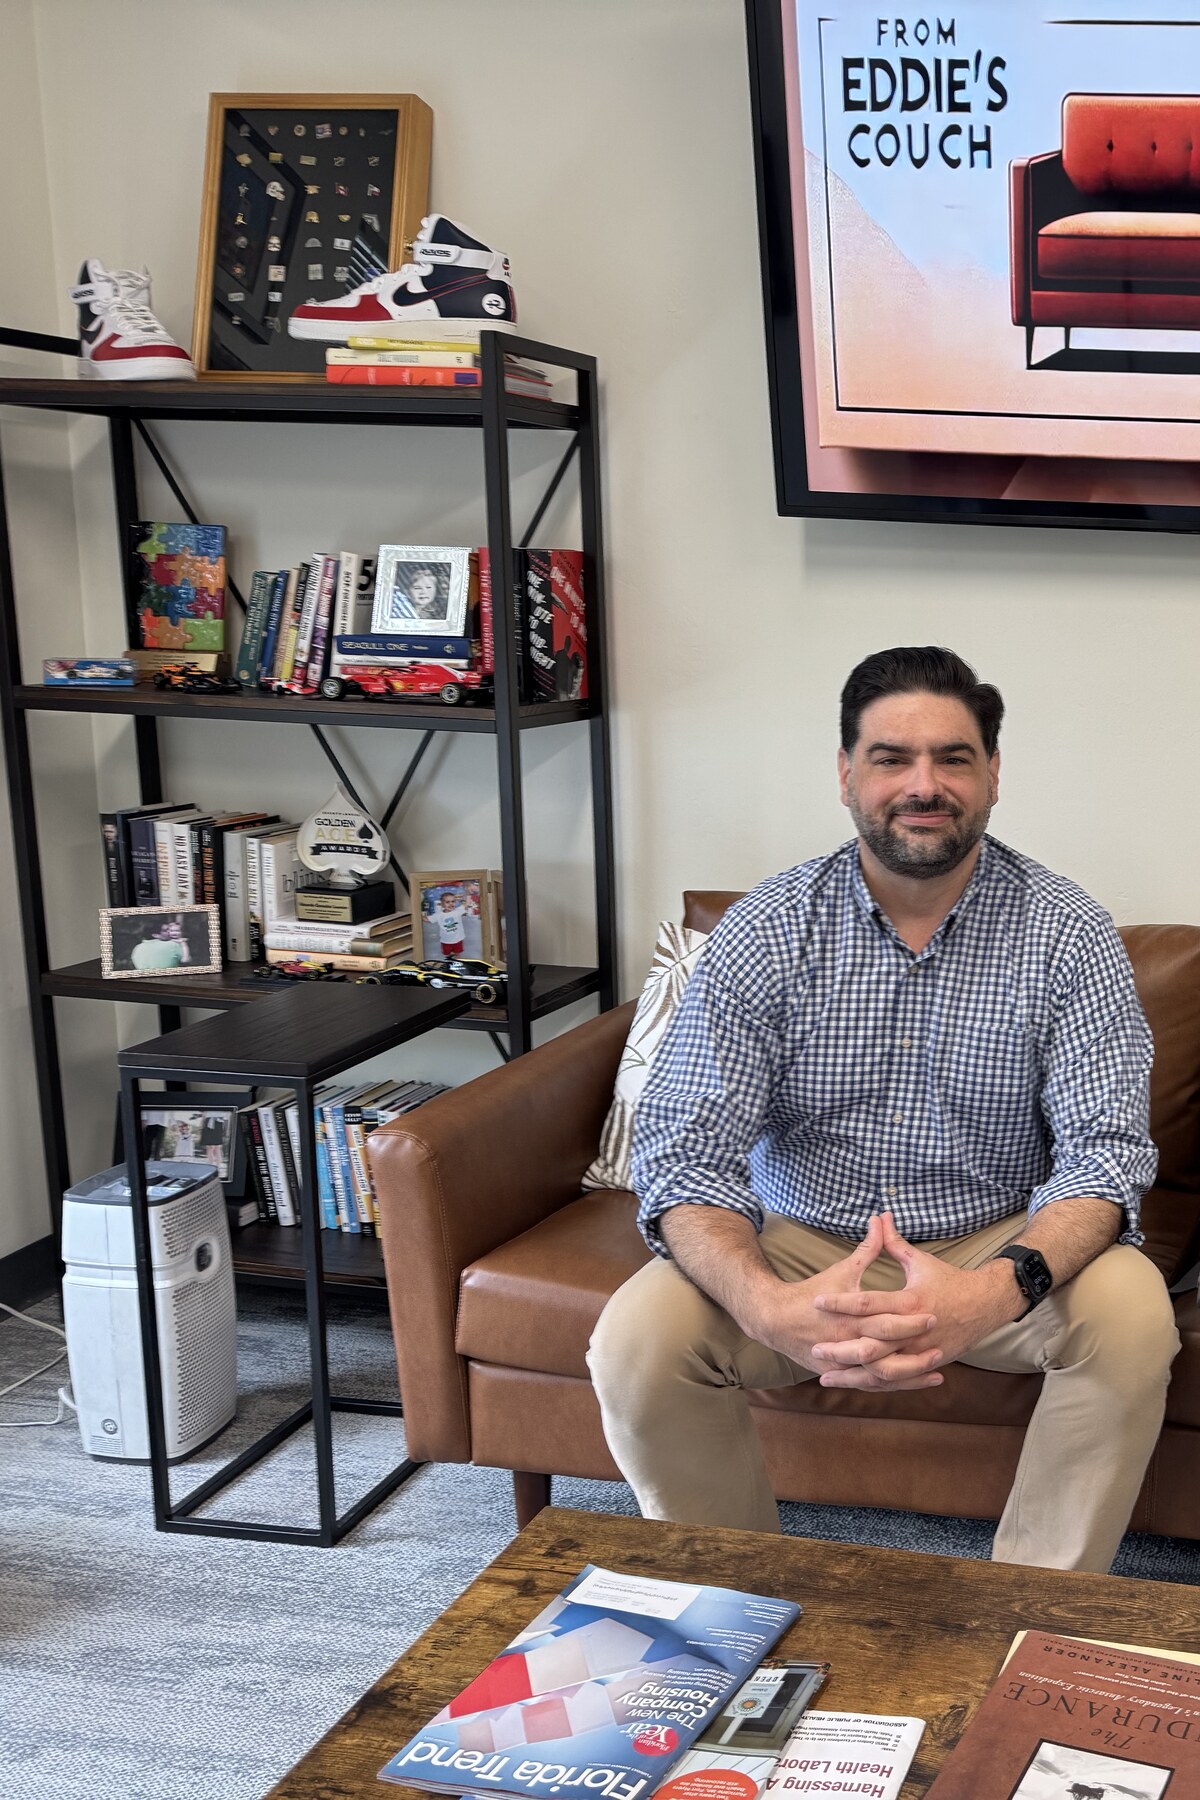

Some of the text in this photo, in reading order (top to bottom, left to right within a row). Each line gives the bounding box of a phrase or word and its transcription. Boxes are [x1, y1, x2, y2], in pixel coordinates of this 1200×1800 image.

[877, 17, 956, 47] FROM
[841, 49, 1008, 113] EDDIE'S
[847, 123, 992, 169] COUCH
[308, 557, 322, 591] ARIZONA
[358, 559, 374, 592] 5
[386, 642, 409, 652] ONE
[314, 818, 356, 828] GOLDEN
[156, 842, 170, 891] INSPIRED
[174, 835, 190, 889] NO EASY DAY
[255, 1146, 277, 1217] HOW THE MIGHTY FALL
[351, 1150, 369, 1192] TECHNOLOGY
[1042, 1645, 1151, 1674] ALEXANDER
[1018, 1671, 1075, 1691] Expedition
[1077, 1684, 1125, 1701] Antarctic
[615, 1691, 708, 1718] Company
[638, 1682, 719, 1708] Housing
[1126, 1695, 1183, 1715] Legendary
[625, 1708, 699, 1730] The New
[863, 1719, 908, 1728] ASSOCIATION
[620, 1723, 672, 1744] Year
[638, 1738, 670, 1751] Floridian
[1090, 1728, 1134, 1750] The
[397, 1741, 648, 1800] Florida Trend
[836, 1761, 894, 1779] Health
[782, 1776, 886, 1798] Harnessing
